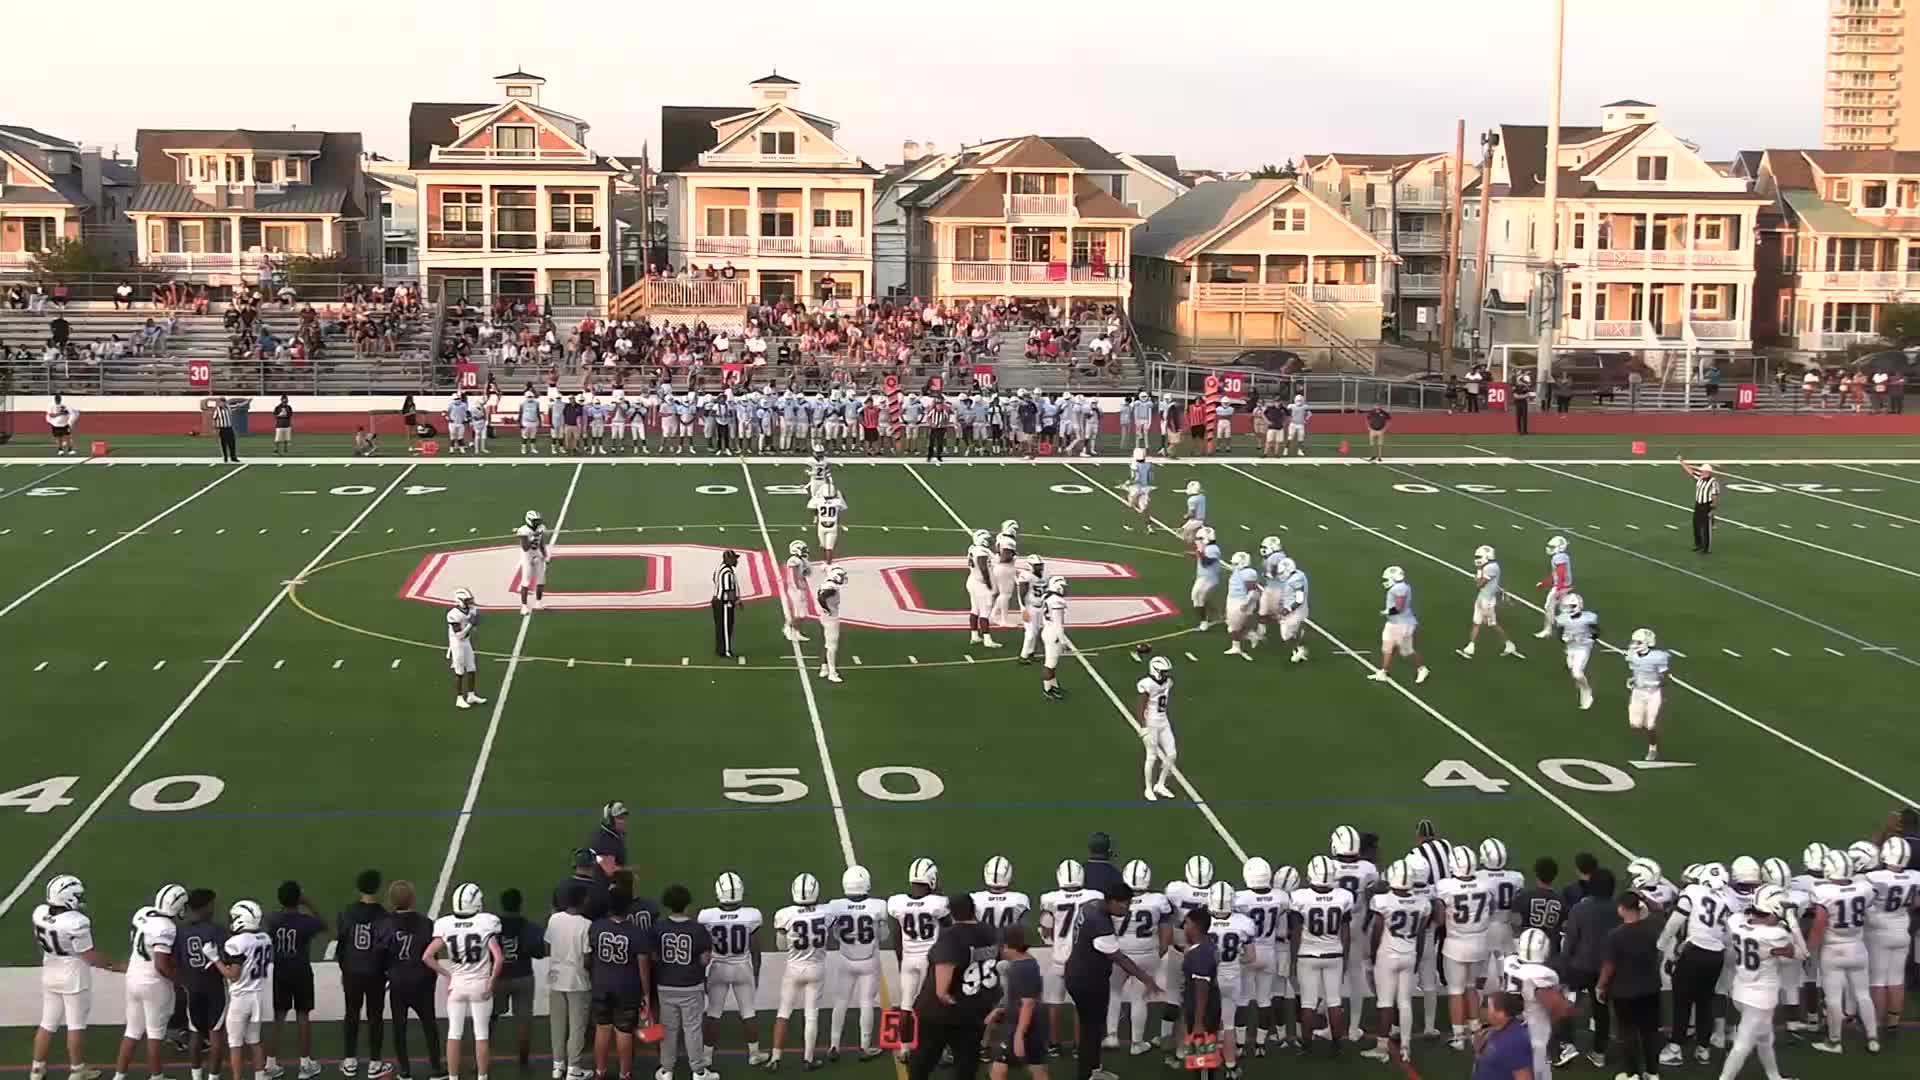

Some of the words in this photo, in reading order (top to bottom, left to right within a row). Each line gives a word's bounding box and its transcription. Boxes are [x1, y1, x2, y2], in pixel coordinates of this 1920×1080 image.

[191, 366, 209, 381] 30
[1223, 378, 1241, 392] 30
[1488, 388, 1505, 403] 20
[1740, 390, 1752, 403] 10
[820, 506, 836, 518] 20
[1308, 907, 1342, 937] 60
[1454, 892, 1487, 924] 57
[1529, 898, 1562, 928] 56
[1833, 896, 1865, 928] 18
[793, 917, 826, 950] 35
[839, 915, 875, 944] 26
[903, 912, 935, 940] 46
[1391, 910, 1419, 938] 21
[36, 926, 68, 956] 51
[276, 927, 298, 954] 11
[446, 933, 484, 964] 16
[599, 932, 629, 965] 63
[662, 932, 692, 965] 69
[711, 924, 747, 955] 30
[962, 959, 998, 995] 95
